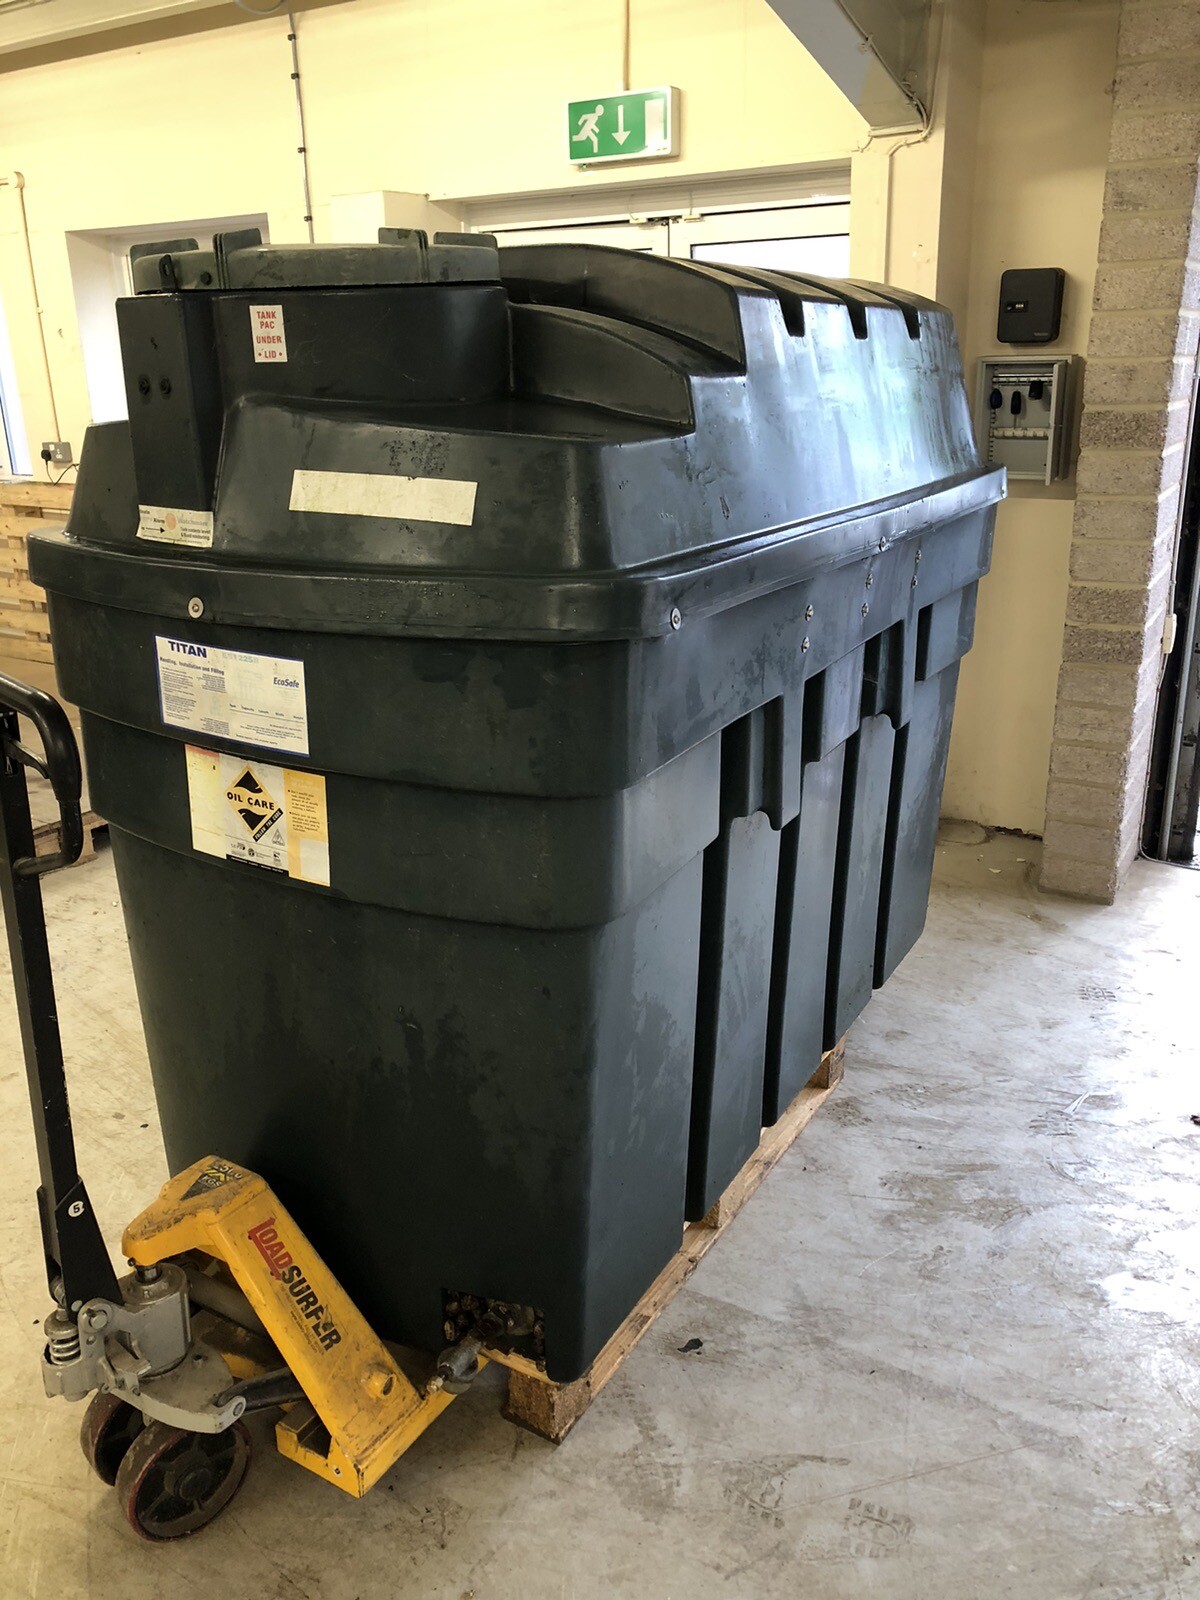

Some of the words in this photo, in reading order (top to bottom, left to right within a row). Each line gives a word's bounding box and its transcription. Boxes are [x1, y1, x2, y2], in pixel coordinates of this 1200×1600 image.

[256, 311, 277, 319] TANK
[260, 321, 275, 329] PAC
[256, 335, 282, 344] UNDER
[264, 350, 277, 359] LID
[168, 640, 207, 658] TITAN
[273, 676, 300, 688] EcoSafe
[227, 792, 244, 803] OIL
[247, 796, 275, 811] CARE
[73, 1203, 81, 1214] 5
